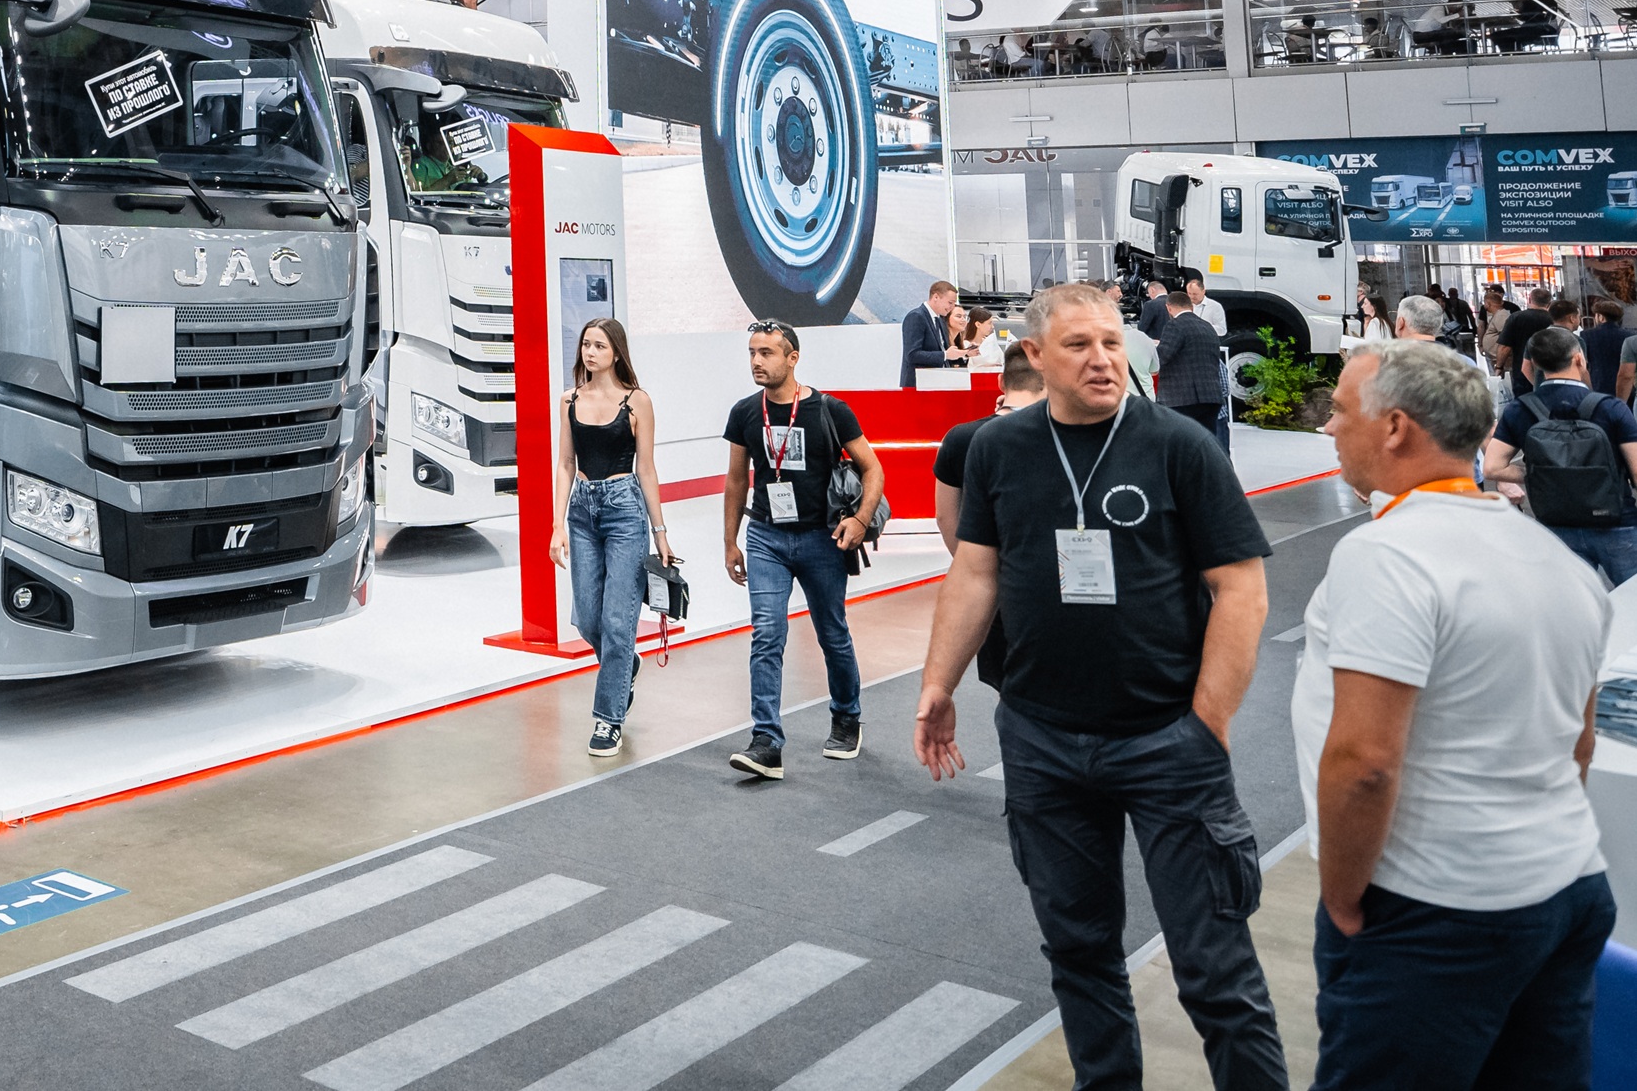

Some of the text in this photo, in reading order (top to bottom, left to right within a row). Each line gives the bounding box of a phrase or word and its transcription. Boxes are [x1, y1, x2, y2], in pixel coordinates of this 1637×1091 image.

[108, 73, 159, 104] ПО СТАВКЕ
[106, 105, 122, 121] ИЗ
[1496, 147, 1615, 165] COMVEX
[1498, 182, 1582, 191] ПРОДОЛЖЕНИЕ
[1499, 191, 1572, 200] ЭКСПОЗИЦИИ
[1514, 211, 1555, 219] УЛИЧНОЙ
[554, 221, 616, 237] JAC MOTORS
[98, 240, 130, 259] K7
[172, 246, 304, 288] JAC
[222, 523, 255, 550] K7
